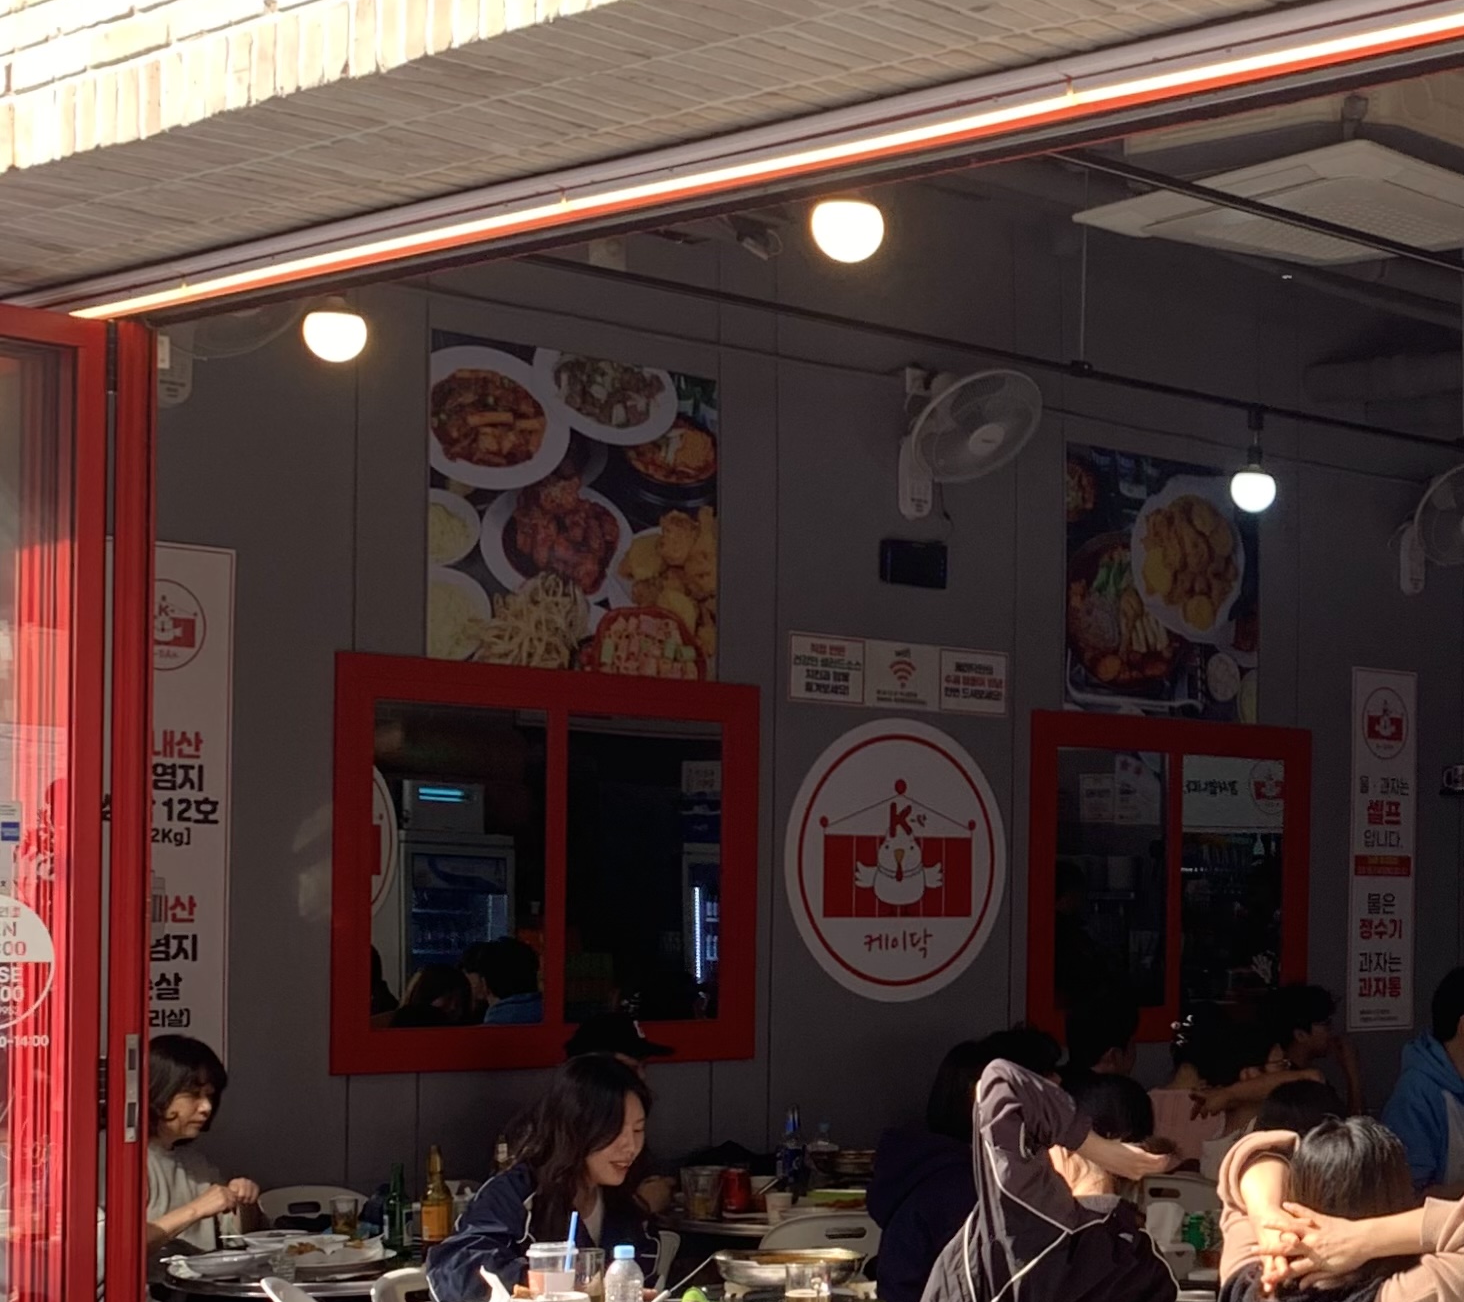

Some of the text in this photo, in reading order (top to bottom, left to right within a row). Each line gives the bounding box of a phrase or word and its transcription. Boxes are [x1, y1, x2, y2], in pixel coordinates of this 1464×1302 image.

[153, 729, 204, 759] 내산
[152, 763, 205, 792] 염지
[162, 797, 220, 825] 12호
[1368, 799, 1402, 825] 셀프
[151, 827, 191, 847] 2Kg]
[1359, 918, 1402, 940] 정수기
[150, 933, 199, 962] 염지
[1359, 952, 1402, 972] 과자는
[150, 972, 183, 1001] 살
